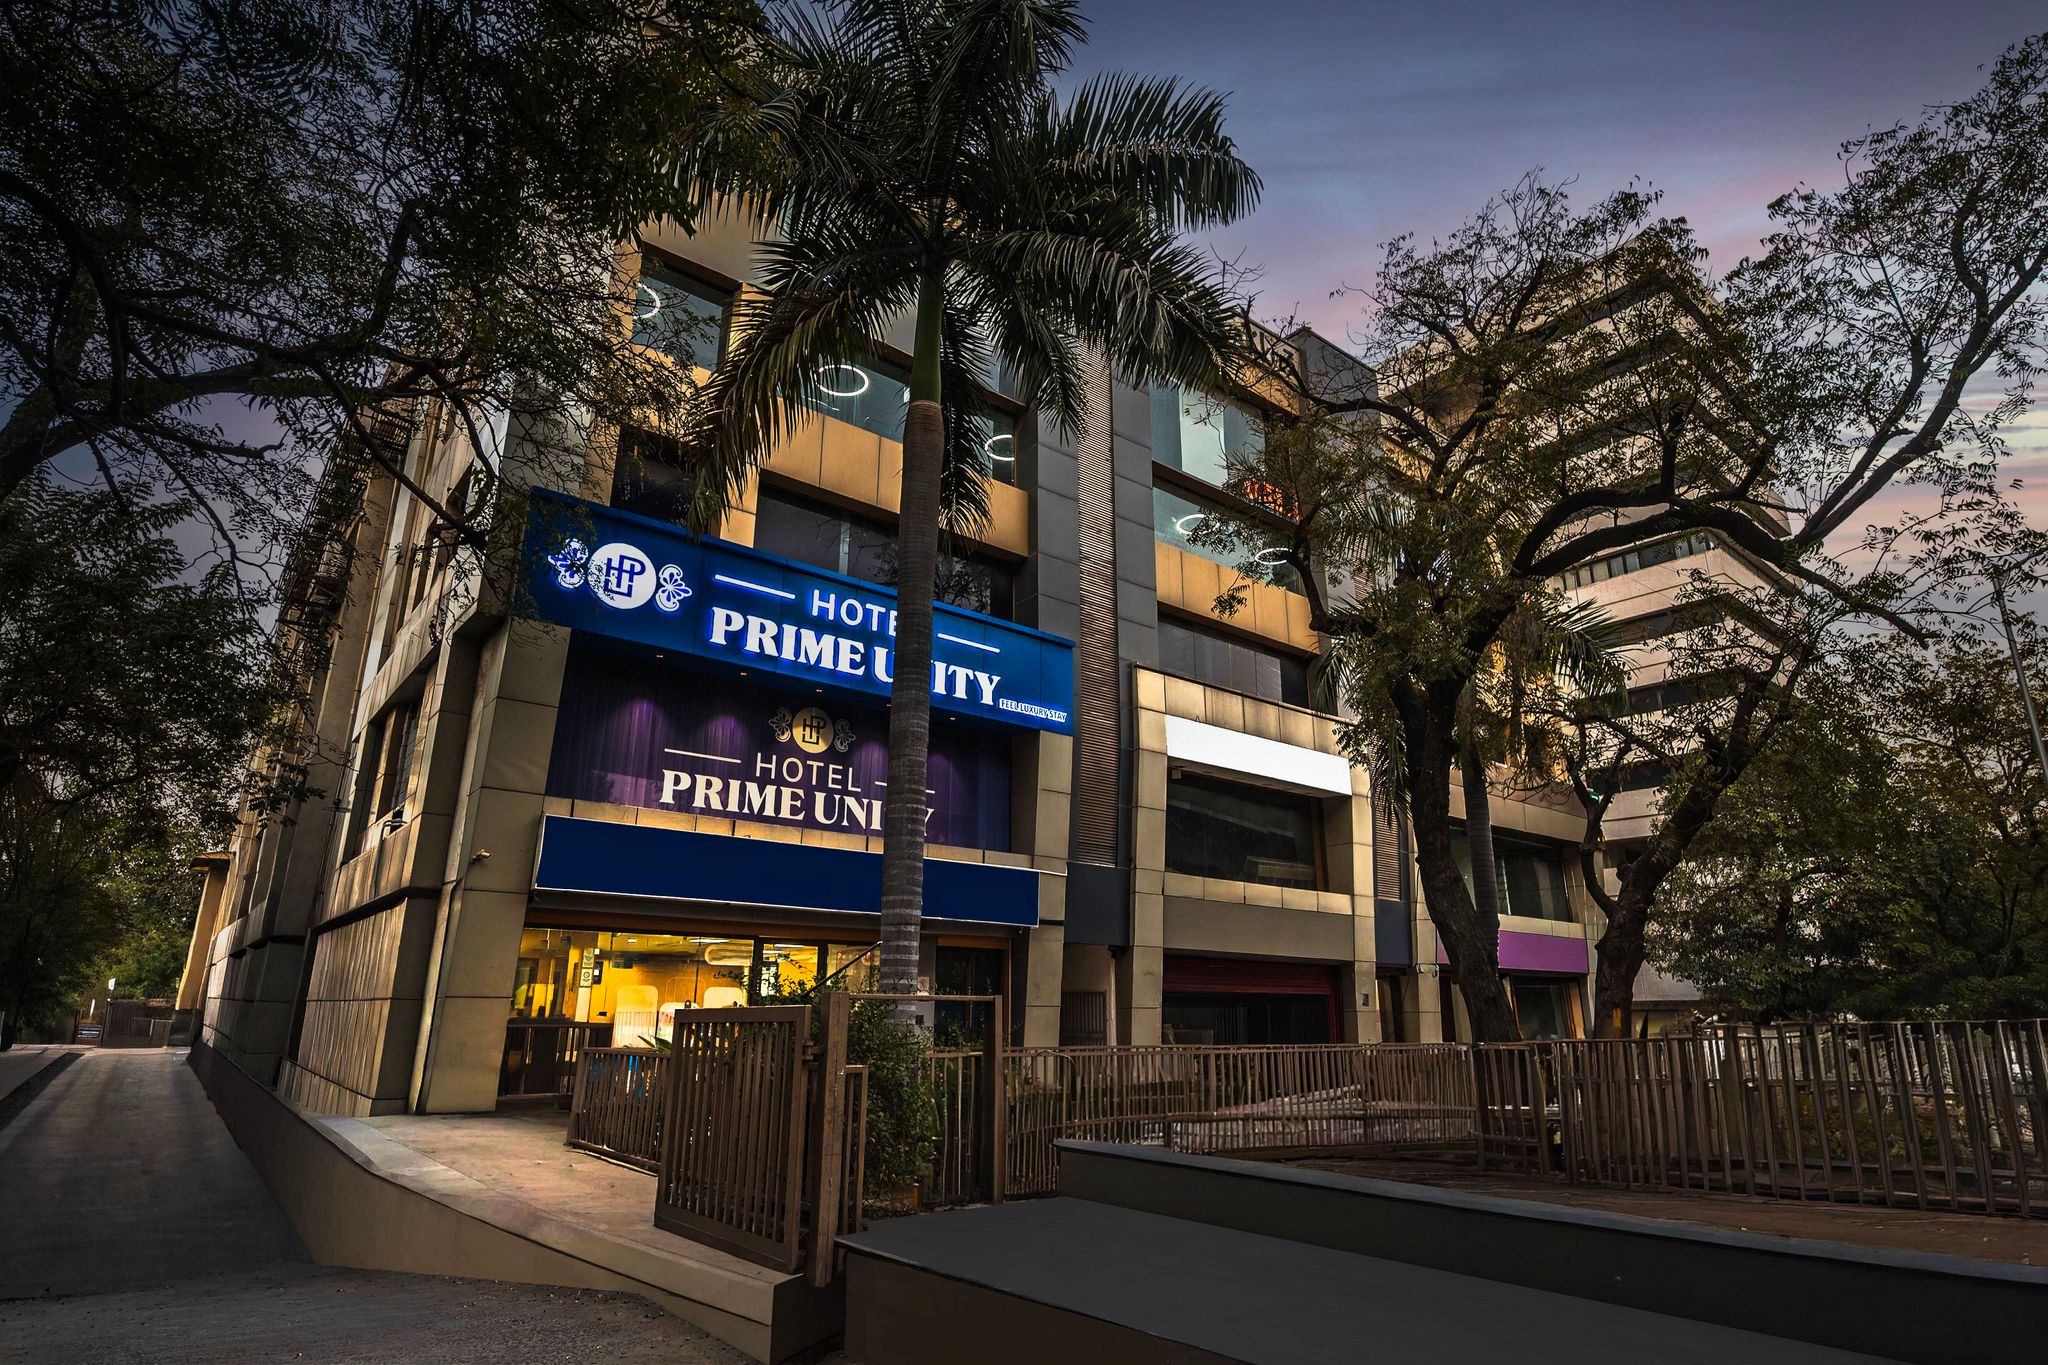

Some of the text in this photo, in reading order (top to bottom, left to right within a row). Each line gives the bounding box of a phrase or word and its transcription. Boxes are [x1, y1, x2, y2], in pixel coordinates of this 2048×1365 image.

[811, 589, 898, 637] HOTE
[709, 606, 1002, 706] PRIME UITY
[1001, 699, 1066, 722] FEEL LUXURY STAY
[659, 769, 806, 821] PRIME
[755, 752, 862, 792] HOTEL
